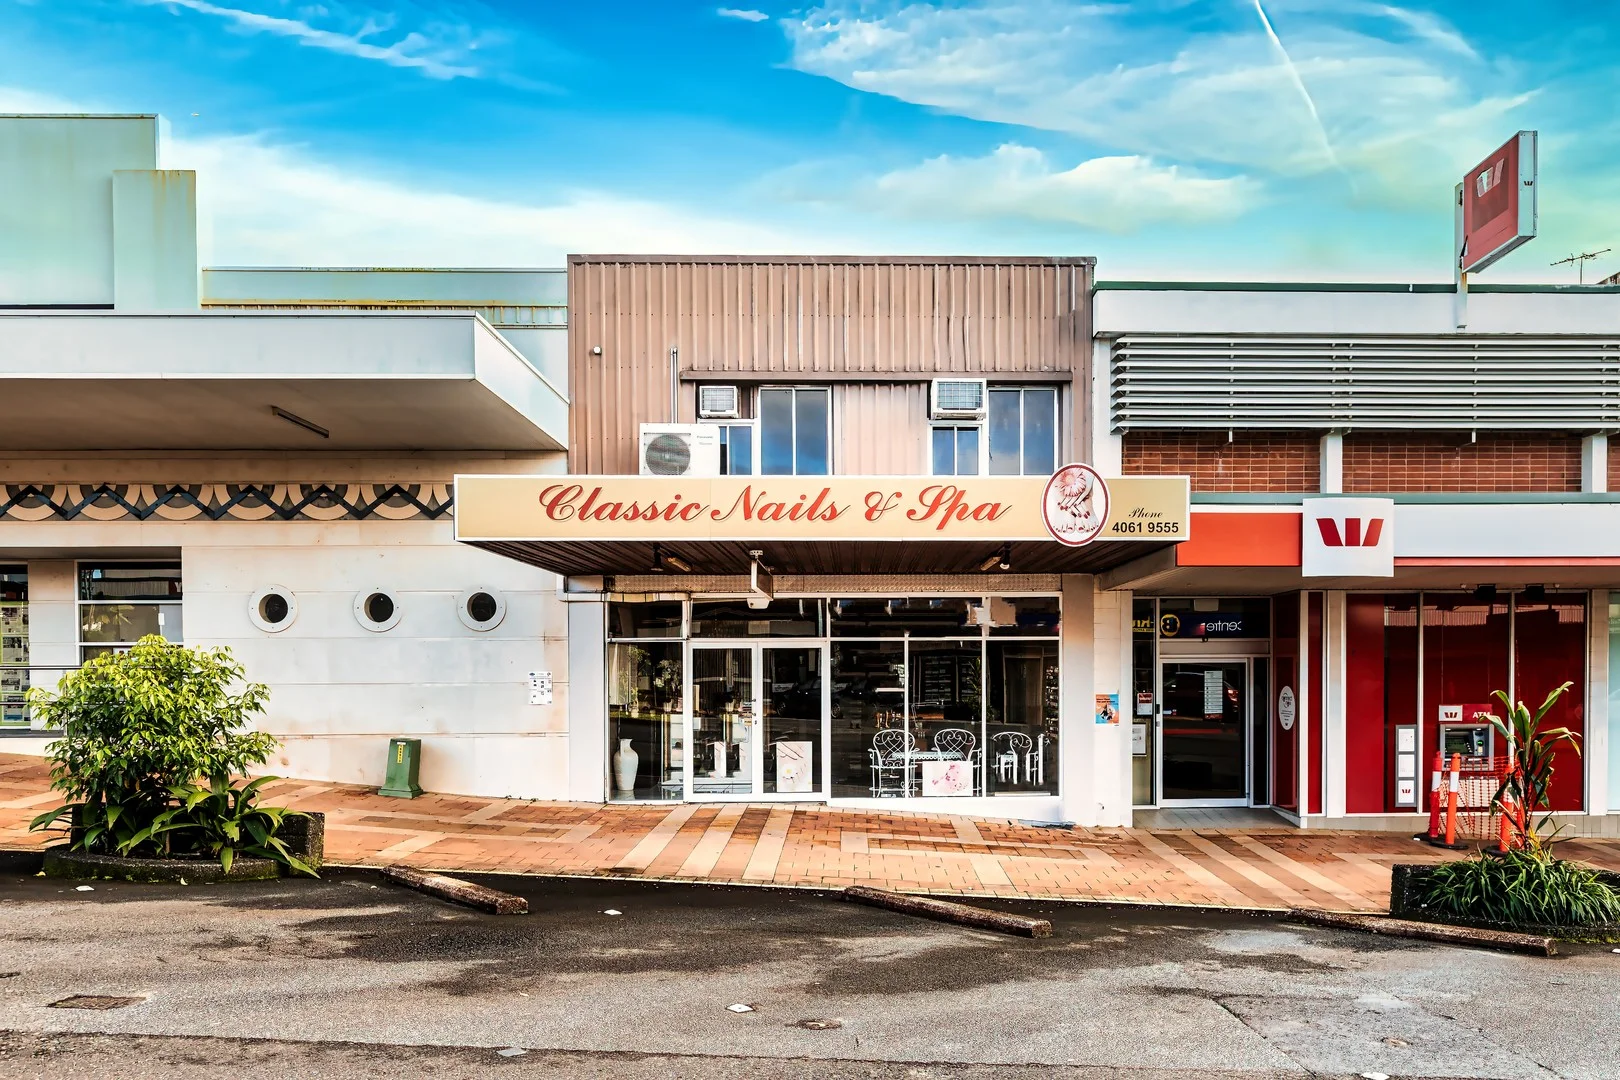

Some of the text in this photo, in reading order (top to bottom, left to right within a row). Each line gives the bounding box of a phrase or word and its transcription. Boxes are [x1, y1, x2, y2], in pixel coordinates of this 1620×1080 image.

[539, 484, 1012, 530] Classic Nails & Spa
[1128, 508, 1164, 518] Phone
[1112, 522, 1179, 533] 4061 9555
